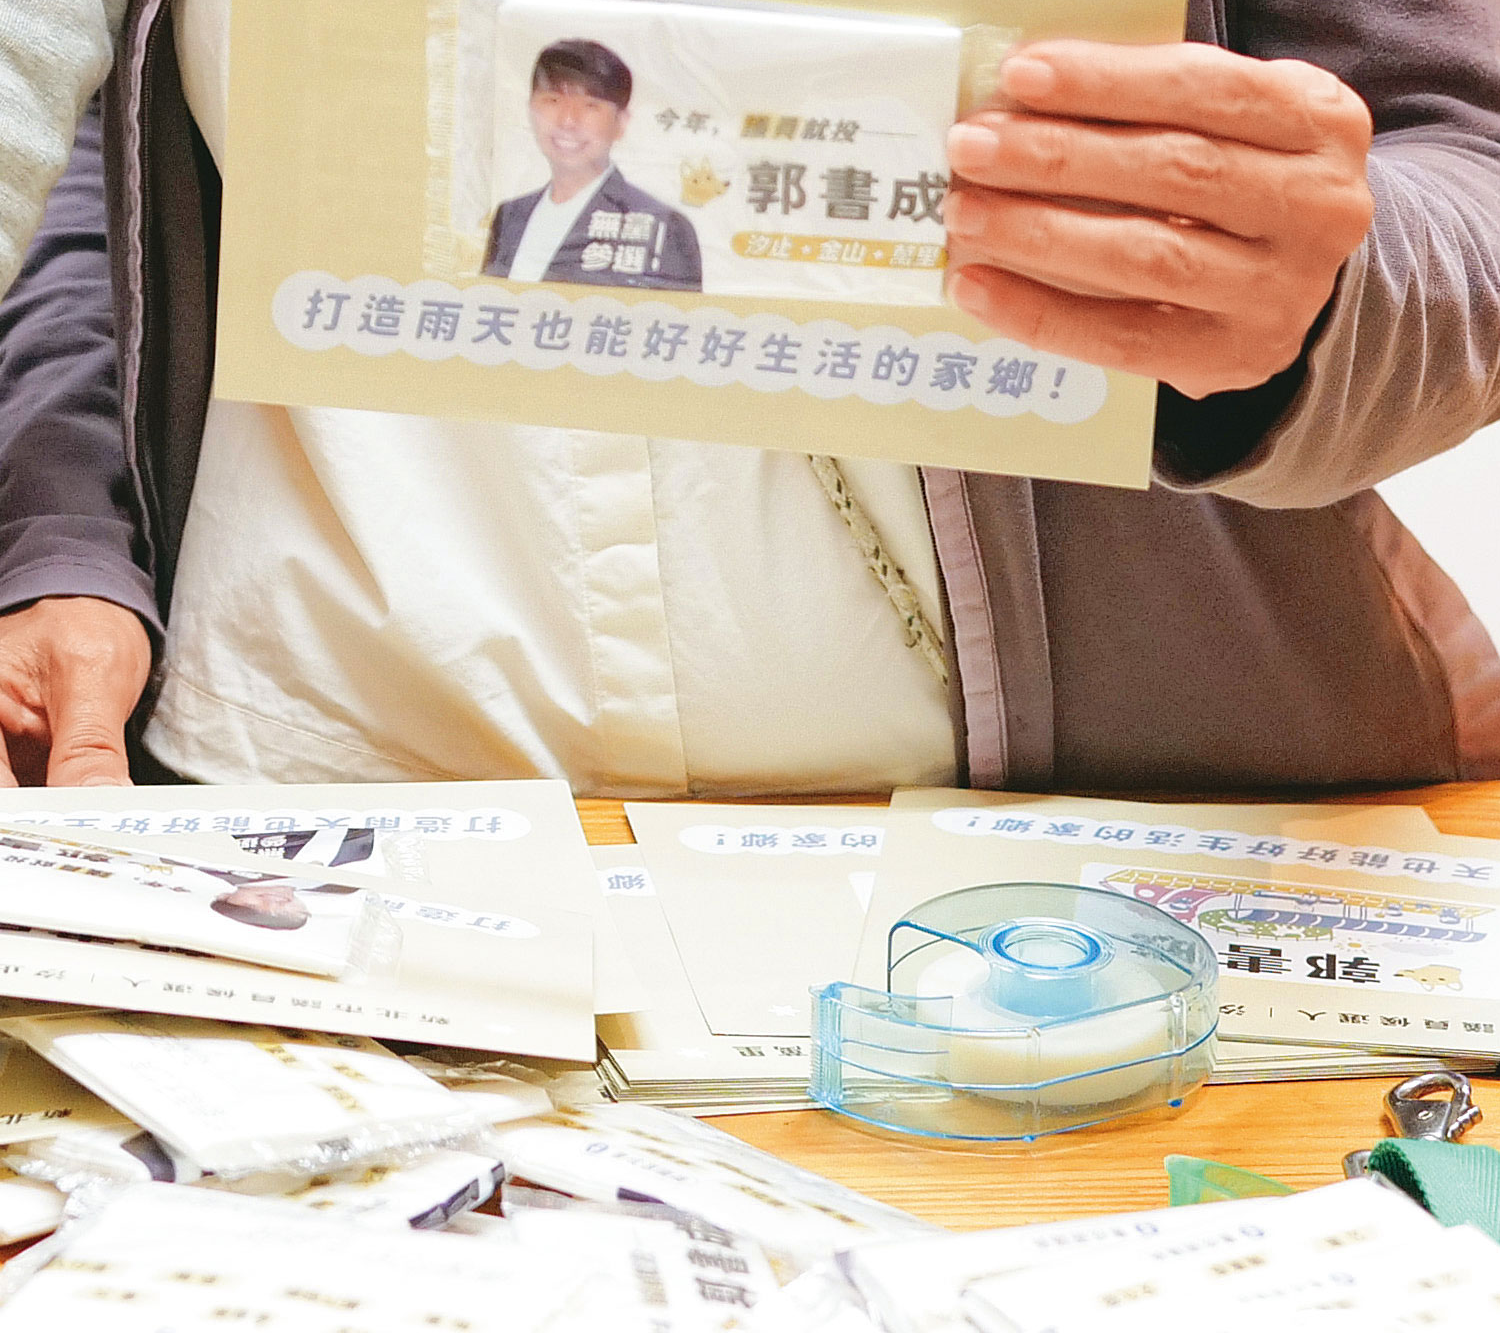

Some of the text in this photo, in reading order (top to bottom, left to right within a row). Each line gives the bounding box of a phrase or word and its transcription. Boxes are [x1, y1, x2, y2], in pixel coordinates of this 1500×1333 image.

[745, 160, 949, 226] 郭書成
[301, 288, 1068, 400] 打造雨天也能好好生活的家鄉!
